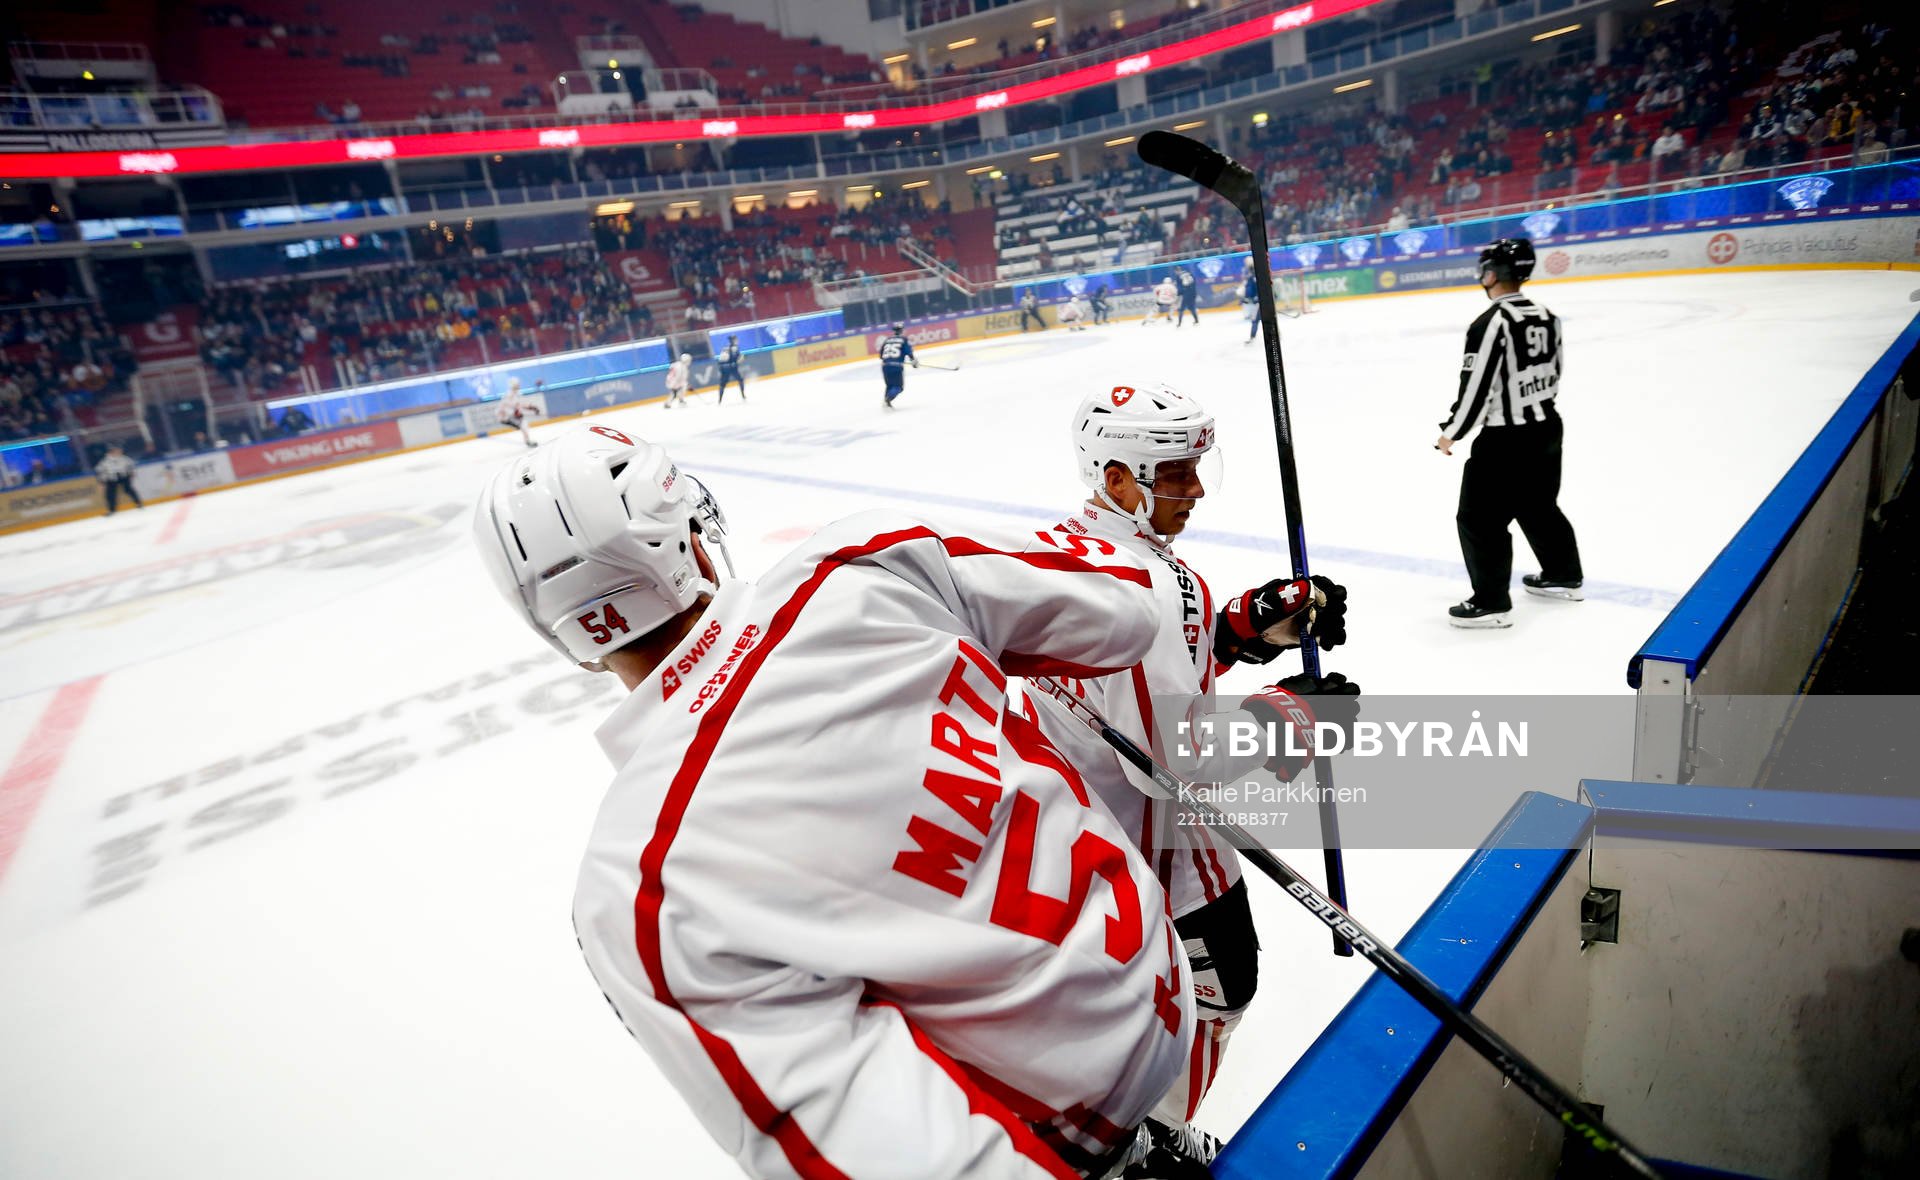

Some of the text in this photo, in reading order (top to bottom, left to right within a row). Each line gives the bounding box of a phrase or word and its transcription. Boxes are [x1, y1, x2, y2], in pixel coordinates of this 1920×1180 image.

[985, 309, 1022, 330] Hert
[577, 602, 630, 645] 54
[677, 619, 722, 675] SWISS
[892, 638, 1007, 899] MARTI
